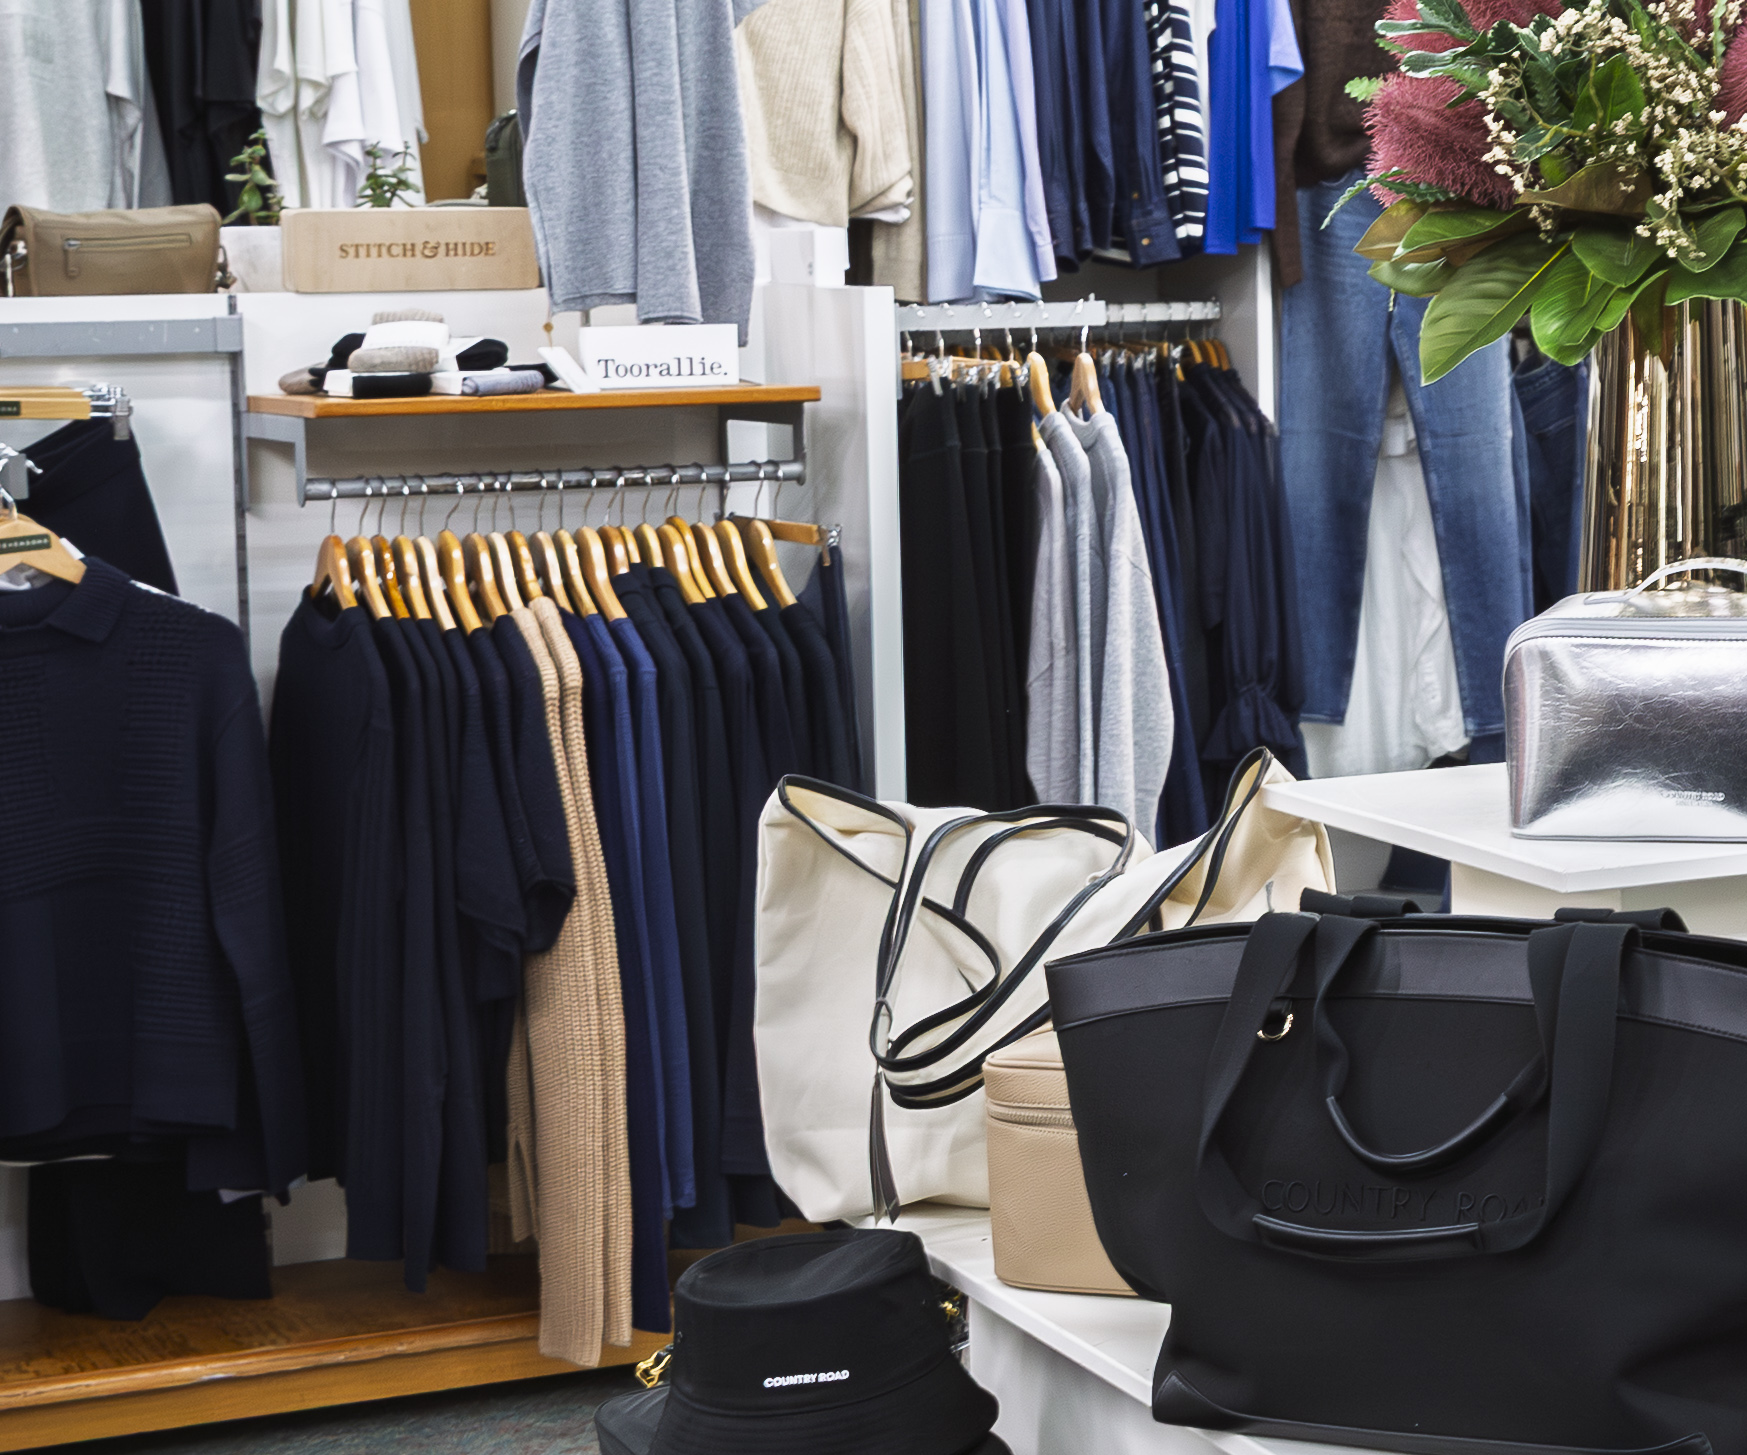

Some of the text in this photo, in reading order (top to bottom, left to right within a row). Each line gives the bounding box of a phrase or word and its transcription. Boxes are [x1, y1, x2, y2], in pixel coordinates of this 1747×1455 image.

[338, 240, 497, 259] STITCH & HIDE
[597, 356, 729, 379] Toorallie.
[1260, 1179, 1438, 1222] COUNTRY
[763, 1369, 850, 1388] COUNTRY ROAD
